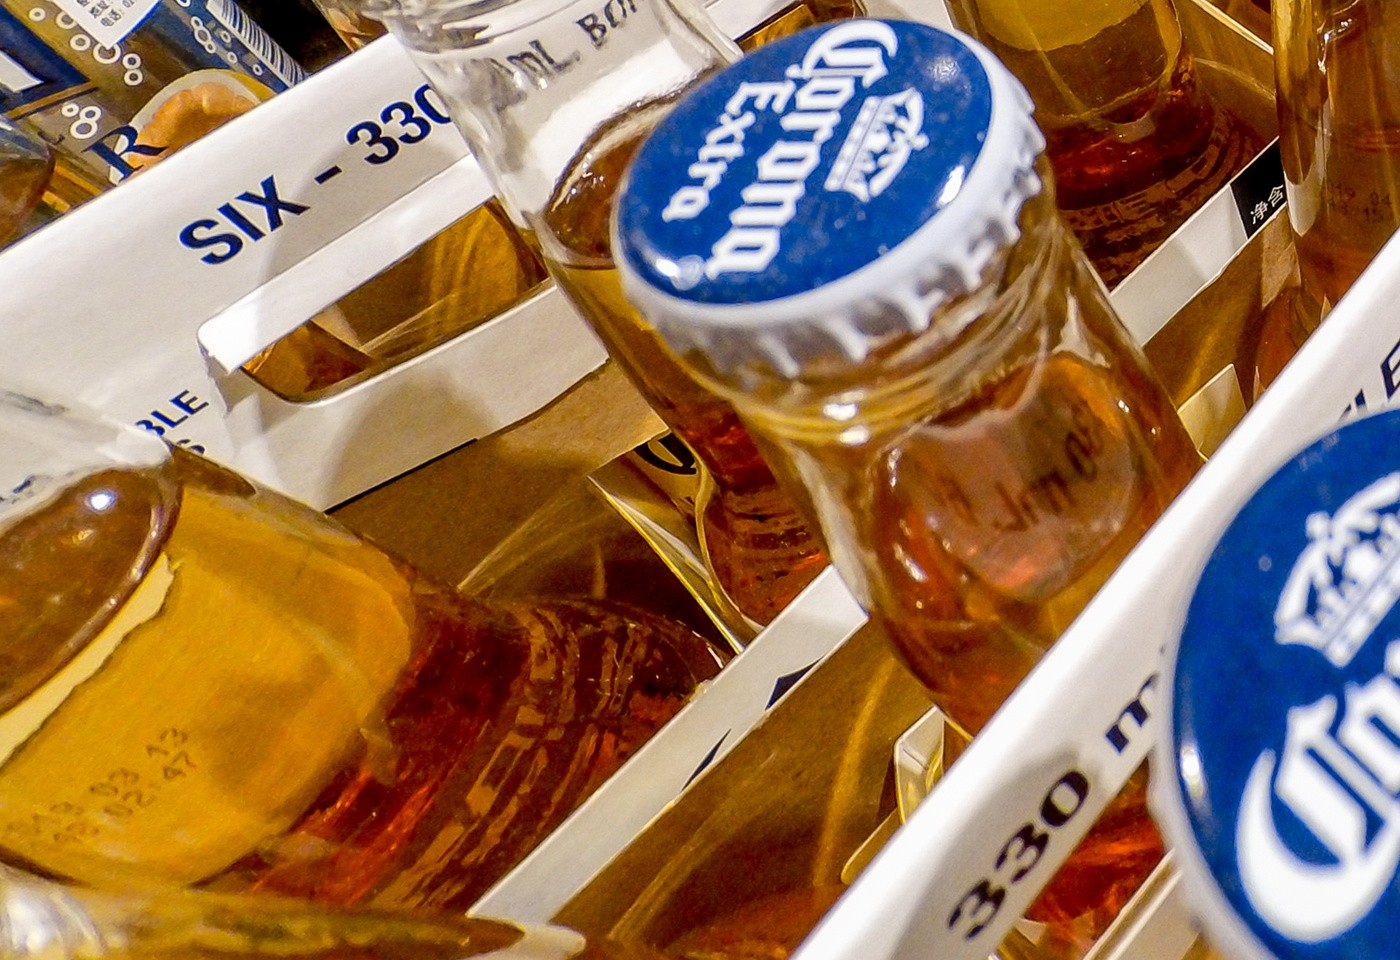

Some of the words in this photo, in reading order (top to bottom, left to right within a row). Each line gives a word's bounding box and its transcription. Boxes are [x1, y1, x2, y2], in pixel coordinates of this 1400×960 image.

[178, 172, 310, 266] SIX
[662, 78, 796, 223] Extra
[703, 20, 898, 280] Corona
[947, 770, 1090, 941] 330
